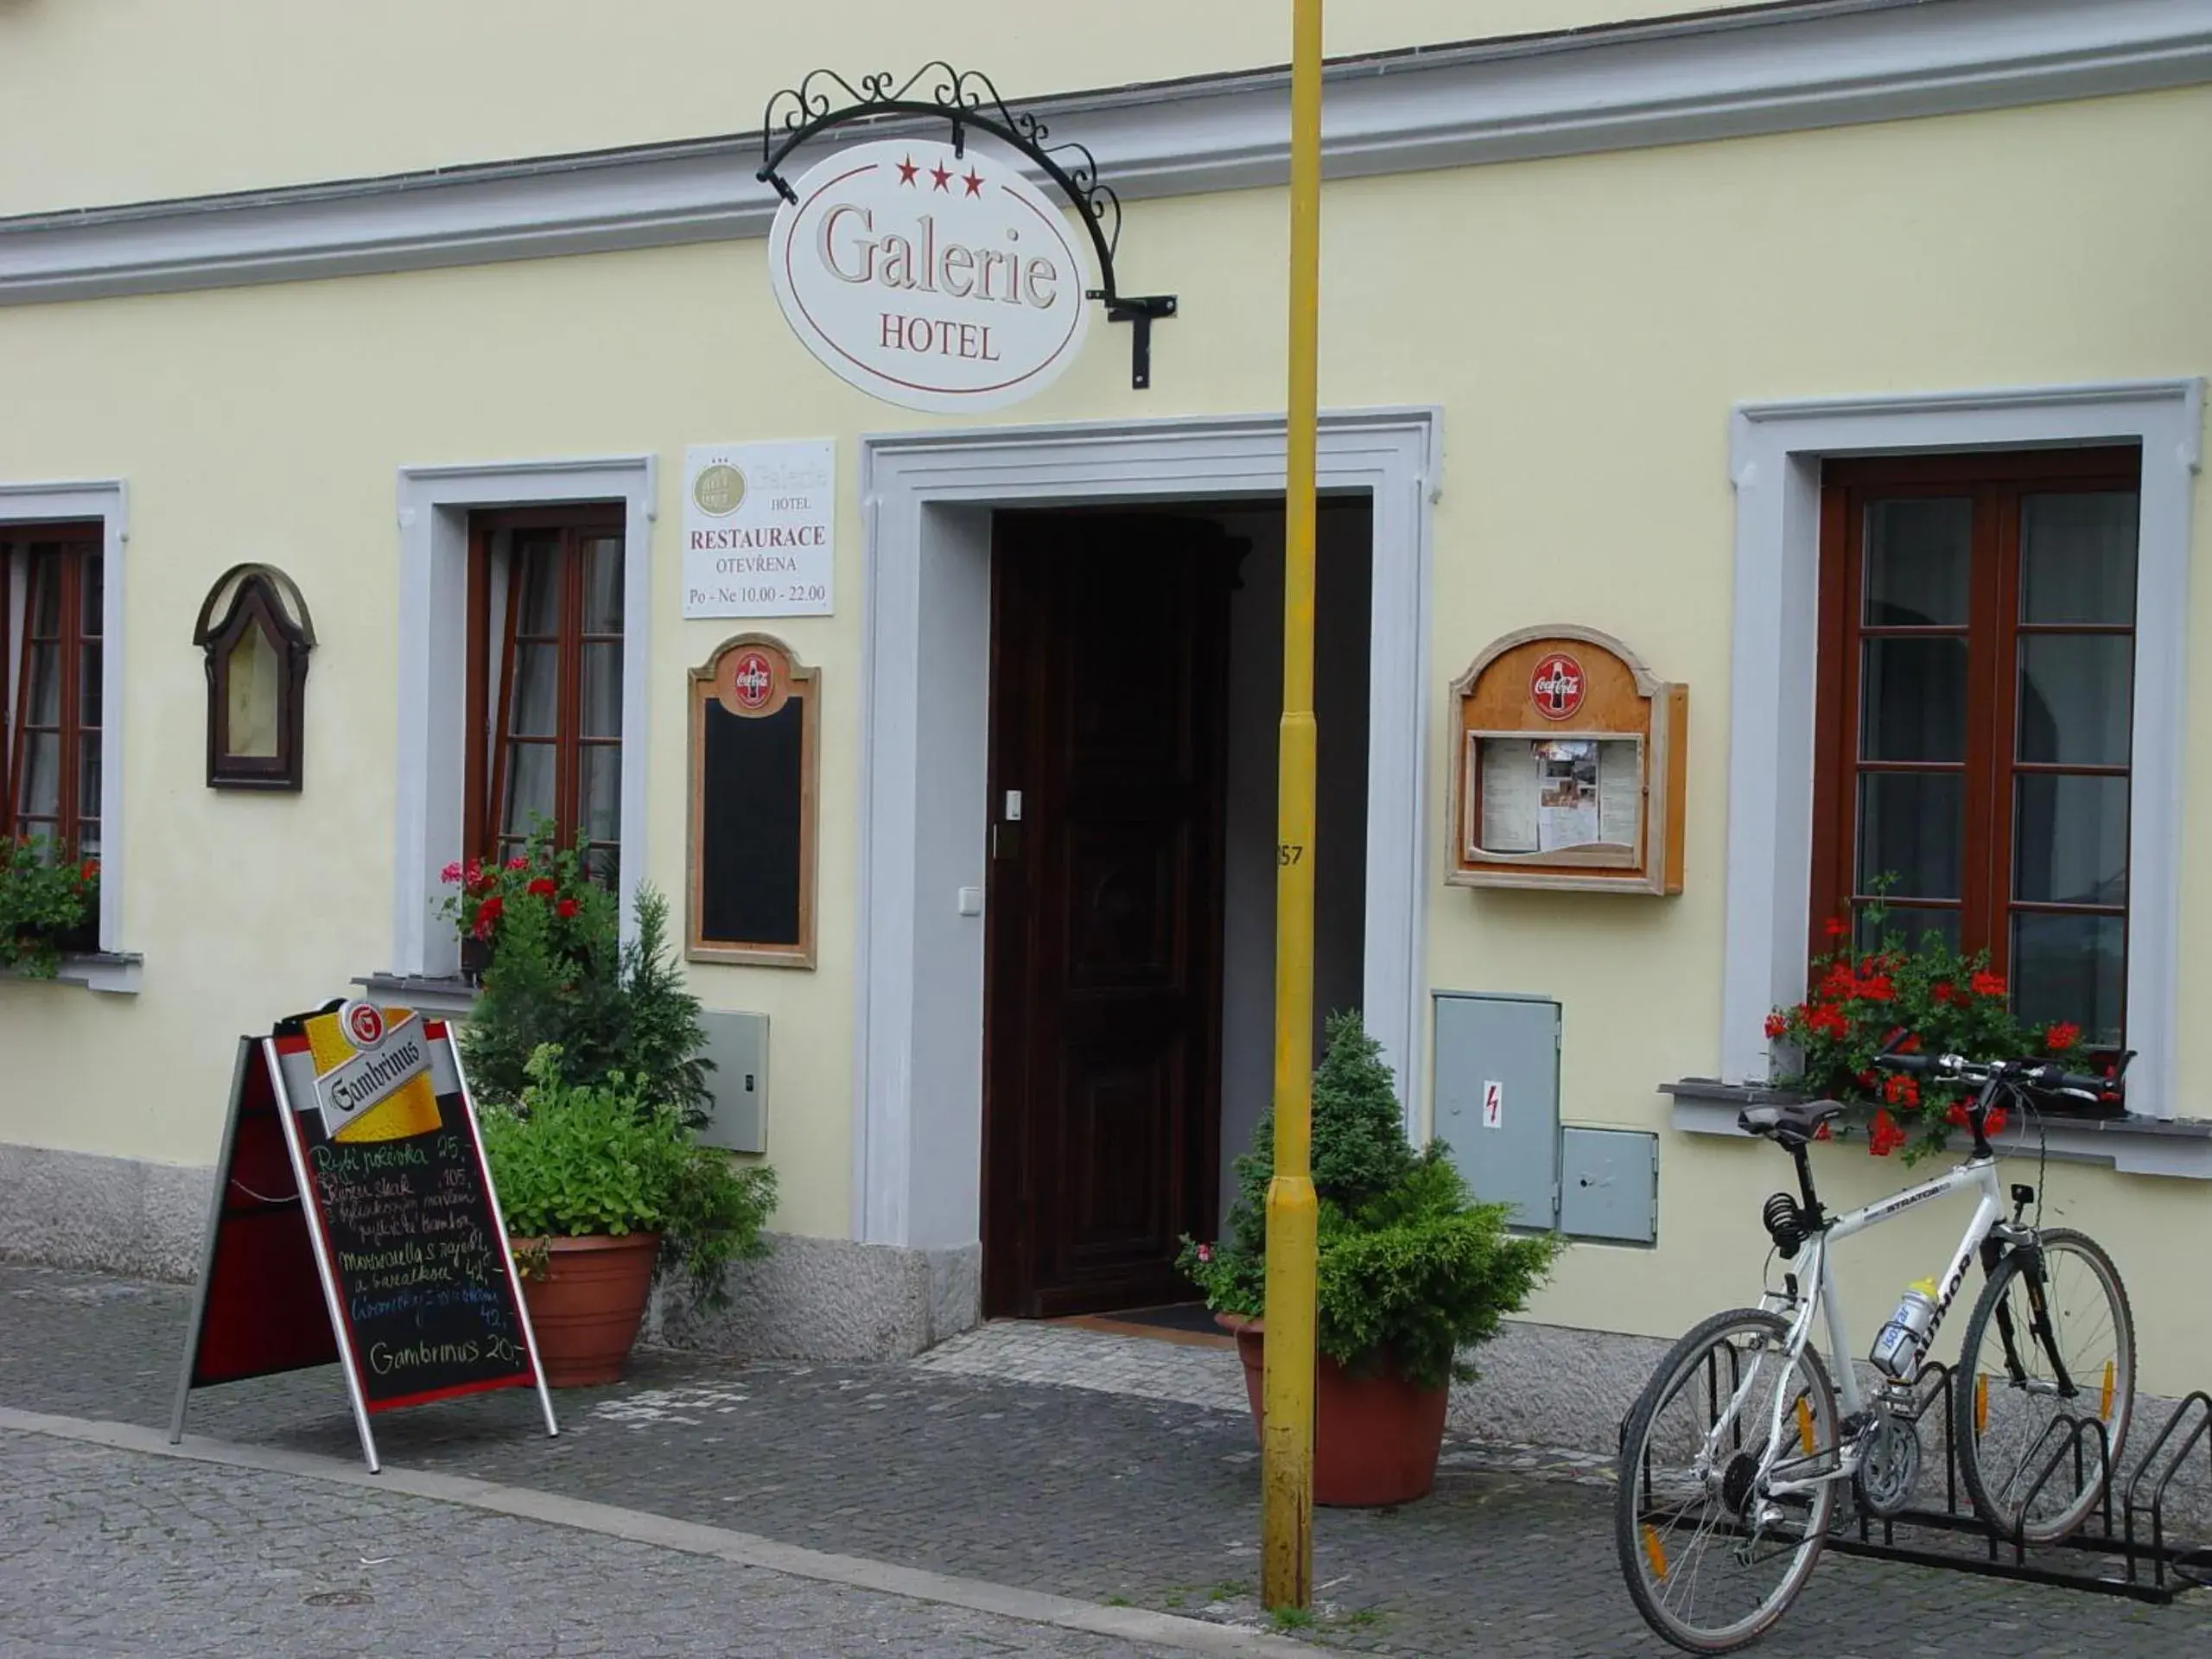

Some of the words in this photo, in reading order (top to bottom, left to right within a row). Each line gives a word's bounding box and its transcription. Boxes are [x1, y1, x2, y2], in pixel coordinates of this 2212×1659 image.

[817, 202, 1057, 309] Galerie
[879, 313, 1001, 362] HOTEL
[771, 497, 810, 510] HOTEL
[690, 525, 826, 550] RESTAURACE
[715, 554, 797, 574] OTEVŘENA
[741, 587, 776, 602] 10.00
[789, 585, 825, 601] 22.00
[1281, 845, 1304, 866] 57
[330, 1040, 420, 1111] Gambrinus
[1915, 1254, 1971, 1371] AUTHOR
[370, 1339, 480, 1375] Gambrinus
